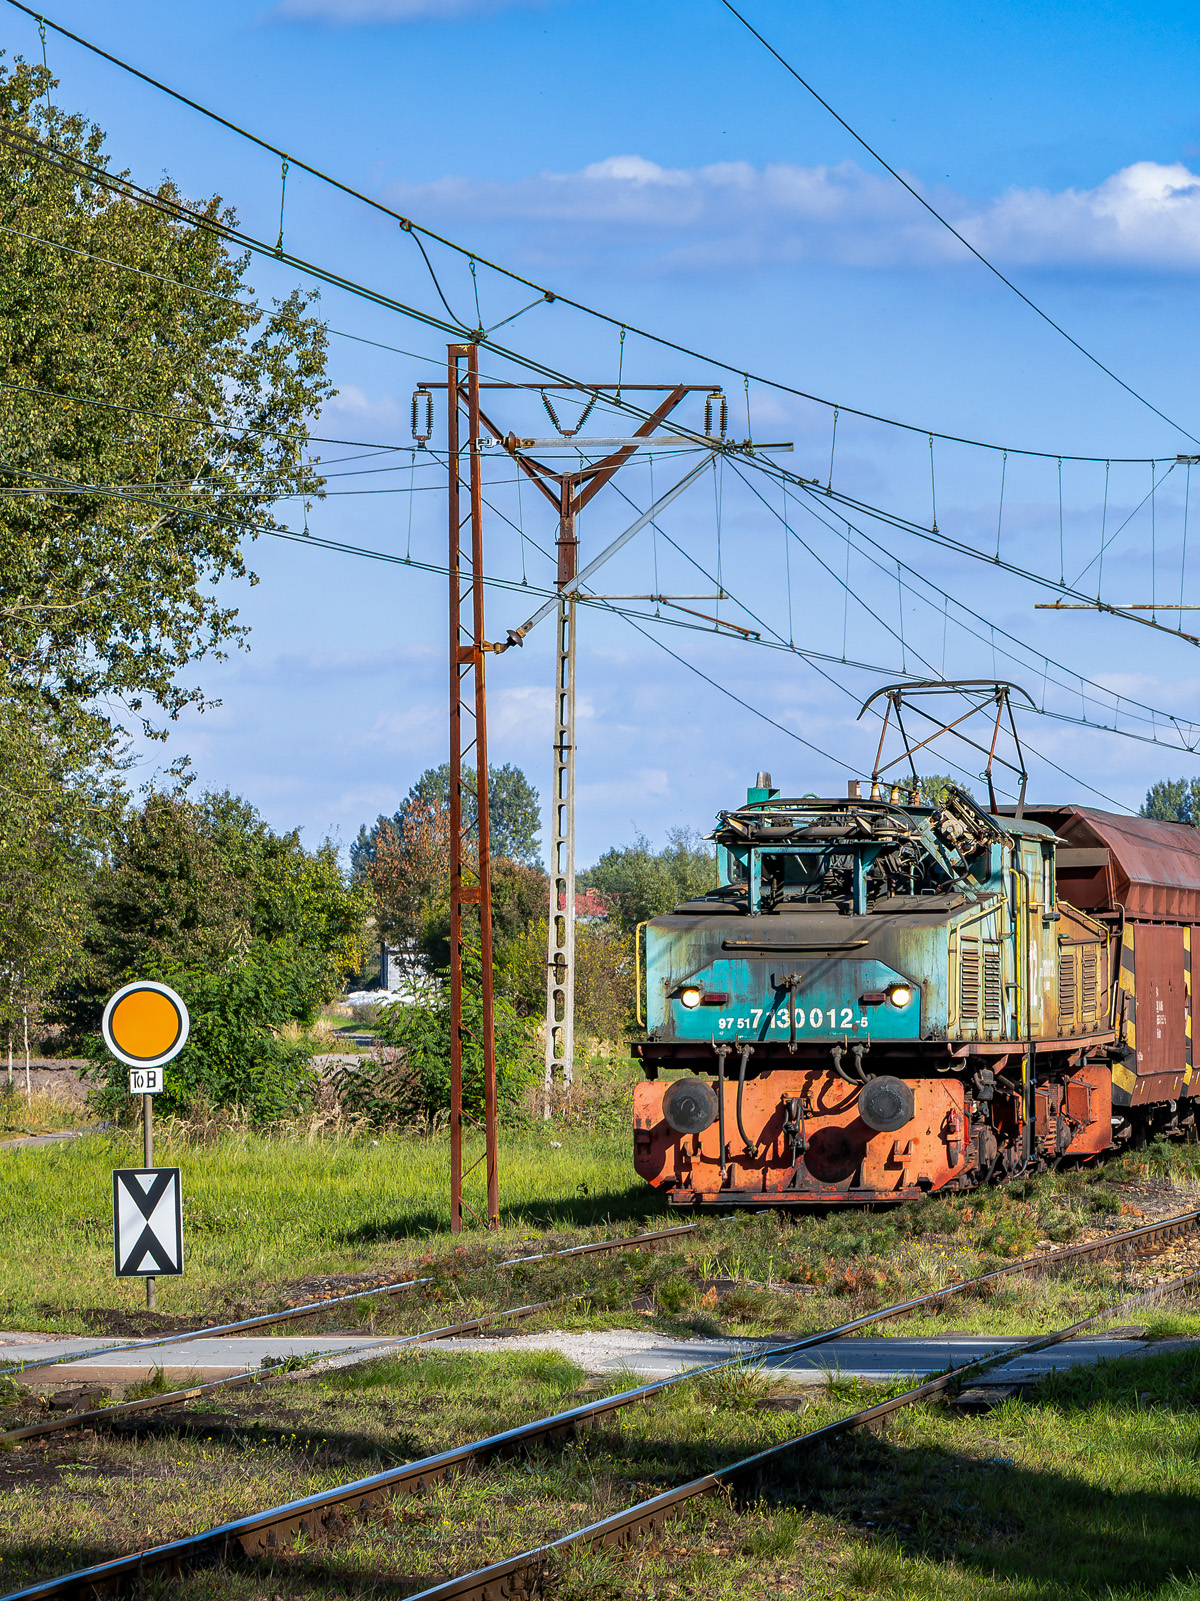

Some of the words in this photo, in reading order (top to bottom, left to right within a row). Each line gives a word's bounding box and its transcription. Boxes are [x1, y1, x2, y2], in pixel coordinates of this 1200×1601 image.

[718, 1018, 734, 1029] 97
[737, 1018, 750, 1029] 51
[147, 1071, 156, 1088] B
